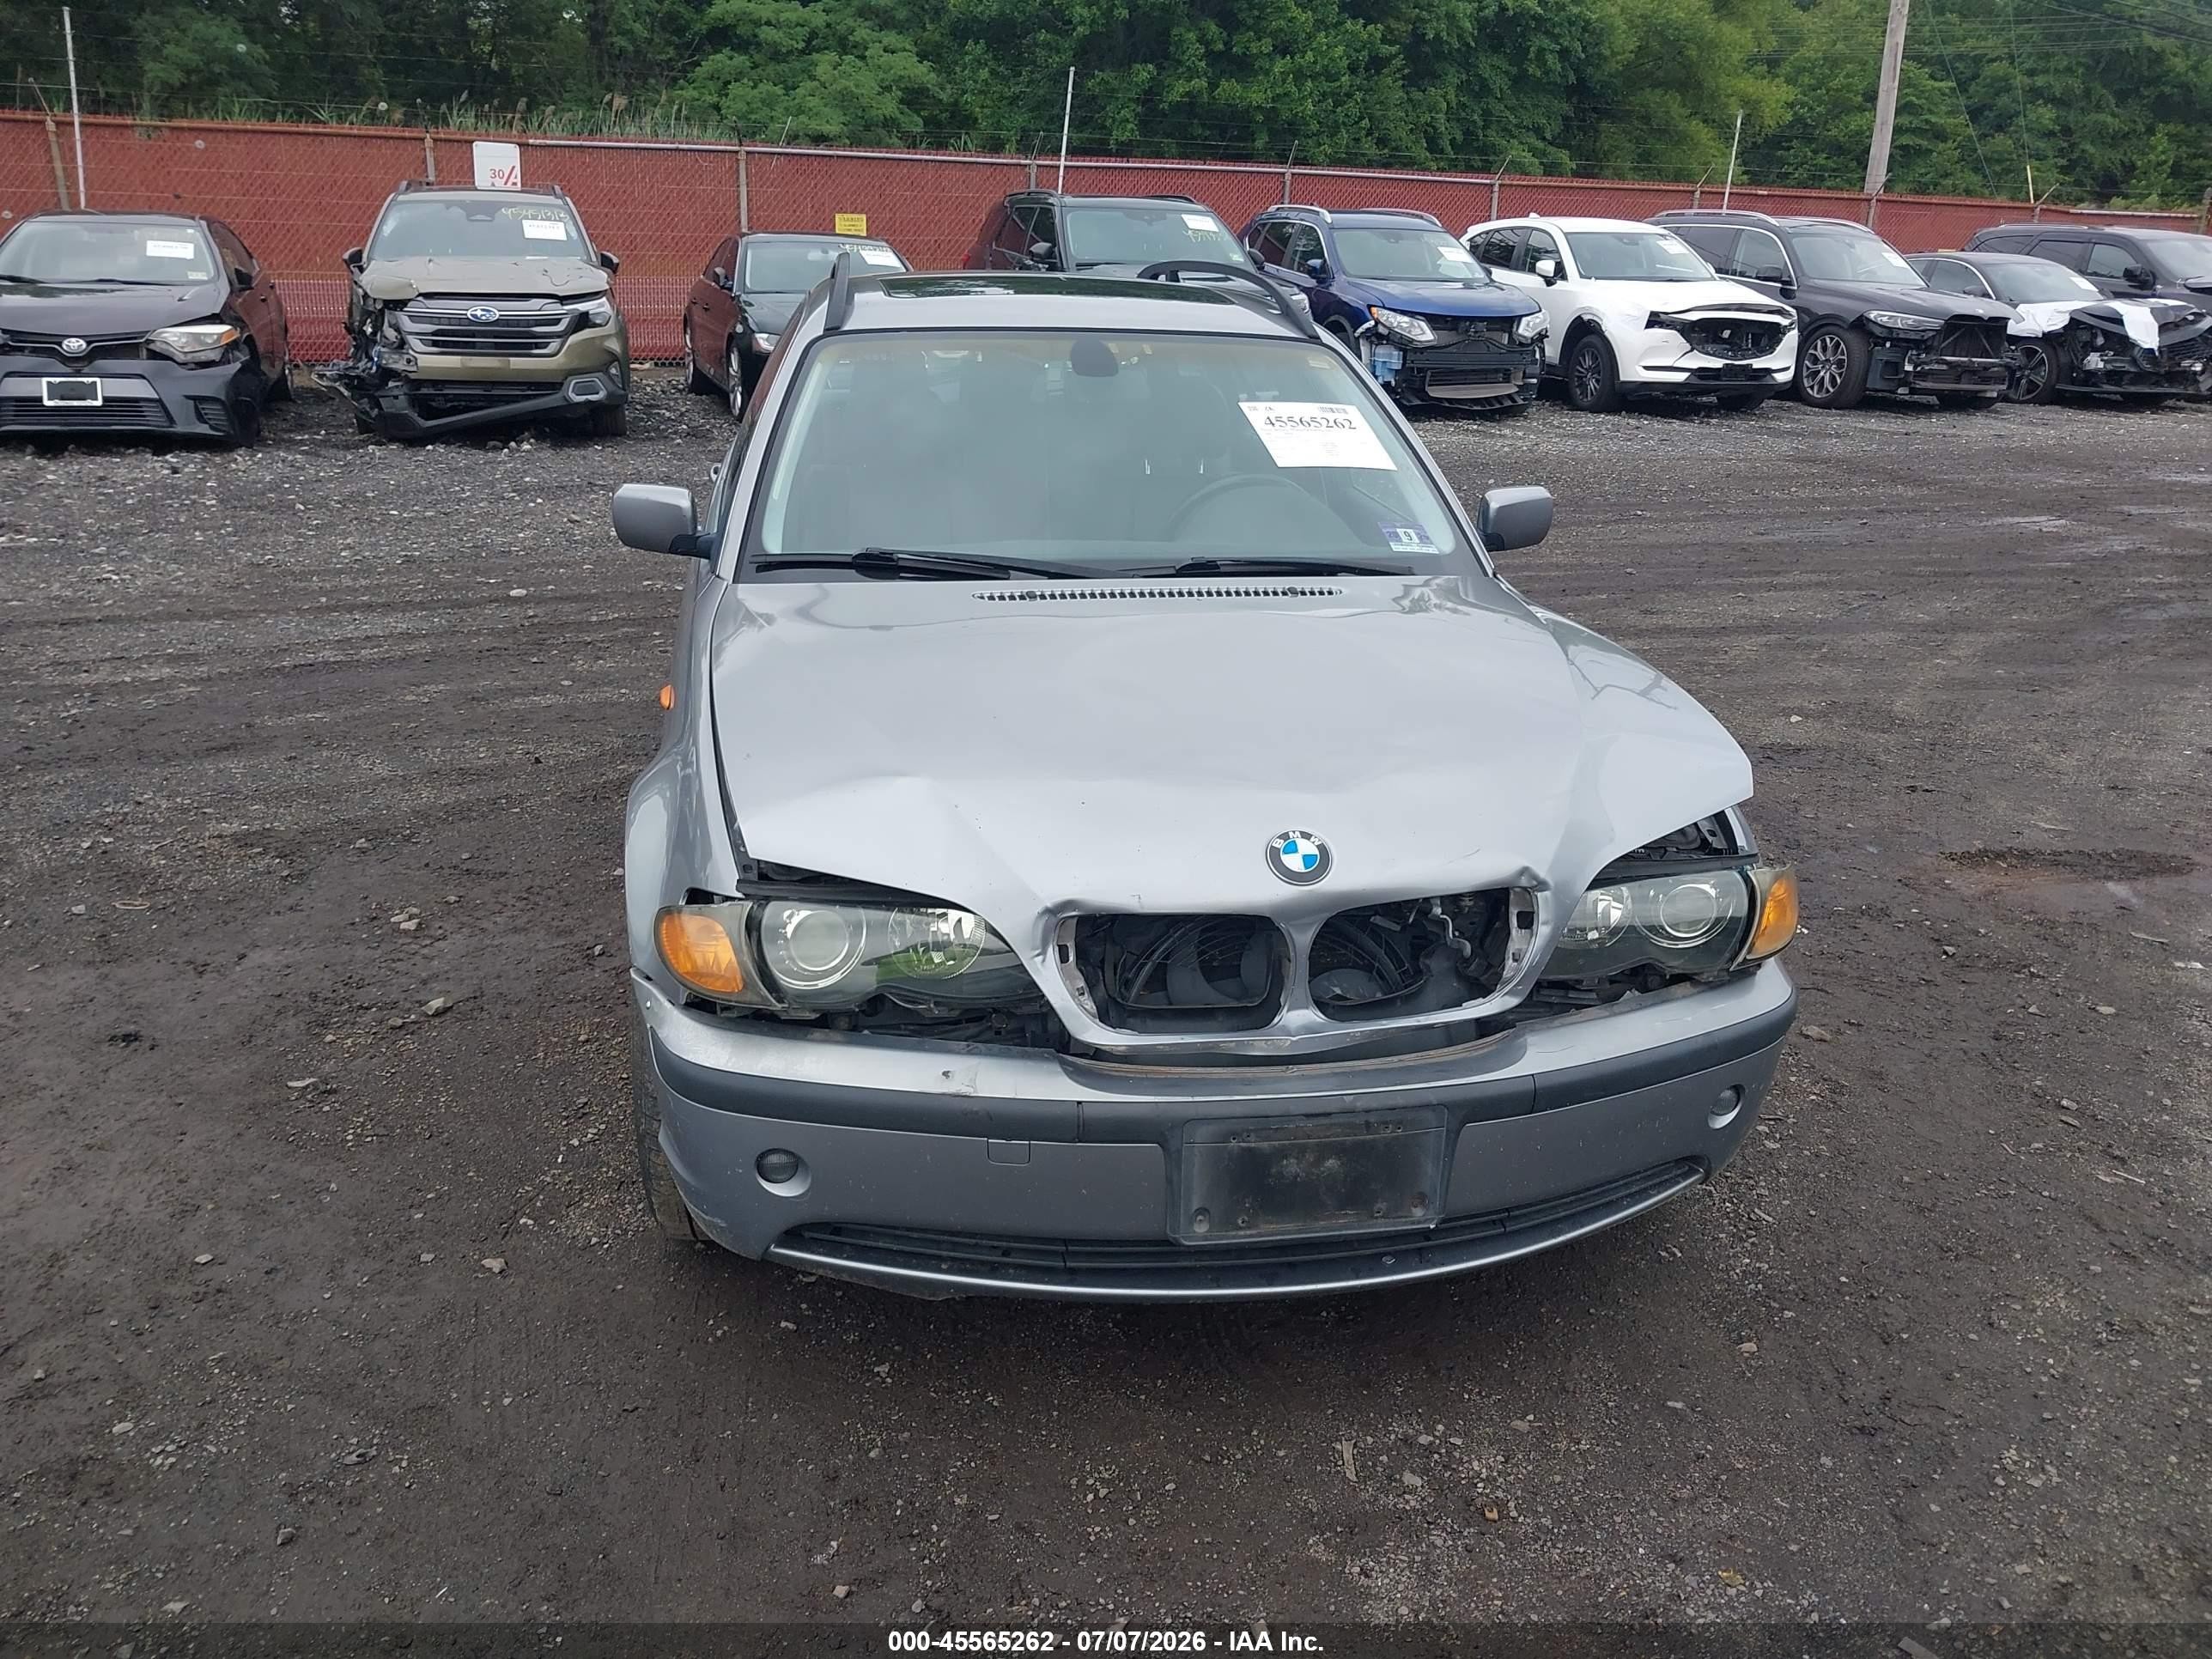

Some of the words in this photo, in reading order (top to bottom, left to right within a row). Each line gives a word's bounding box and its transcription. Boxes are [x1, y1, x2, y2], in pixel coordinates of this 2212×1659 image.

[1264, 416, 1357, 429] 45565262
[1403, 530, 1413, 541] 9
[1271, 830, 1322, 849] BMW
